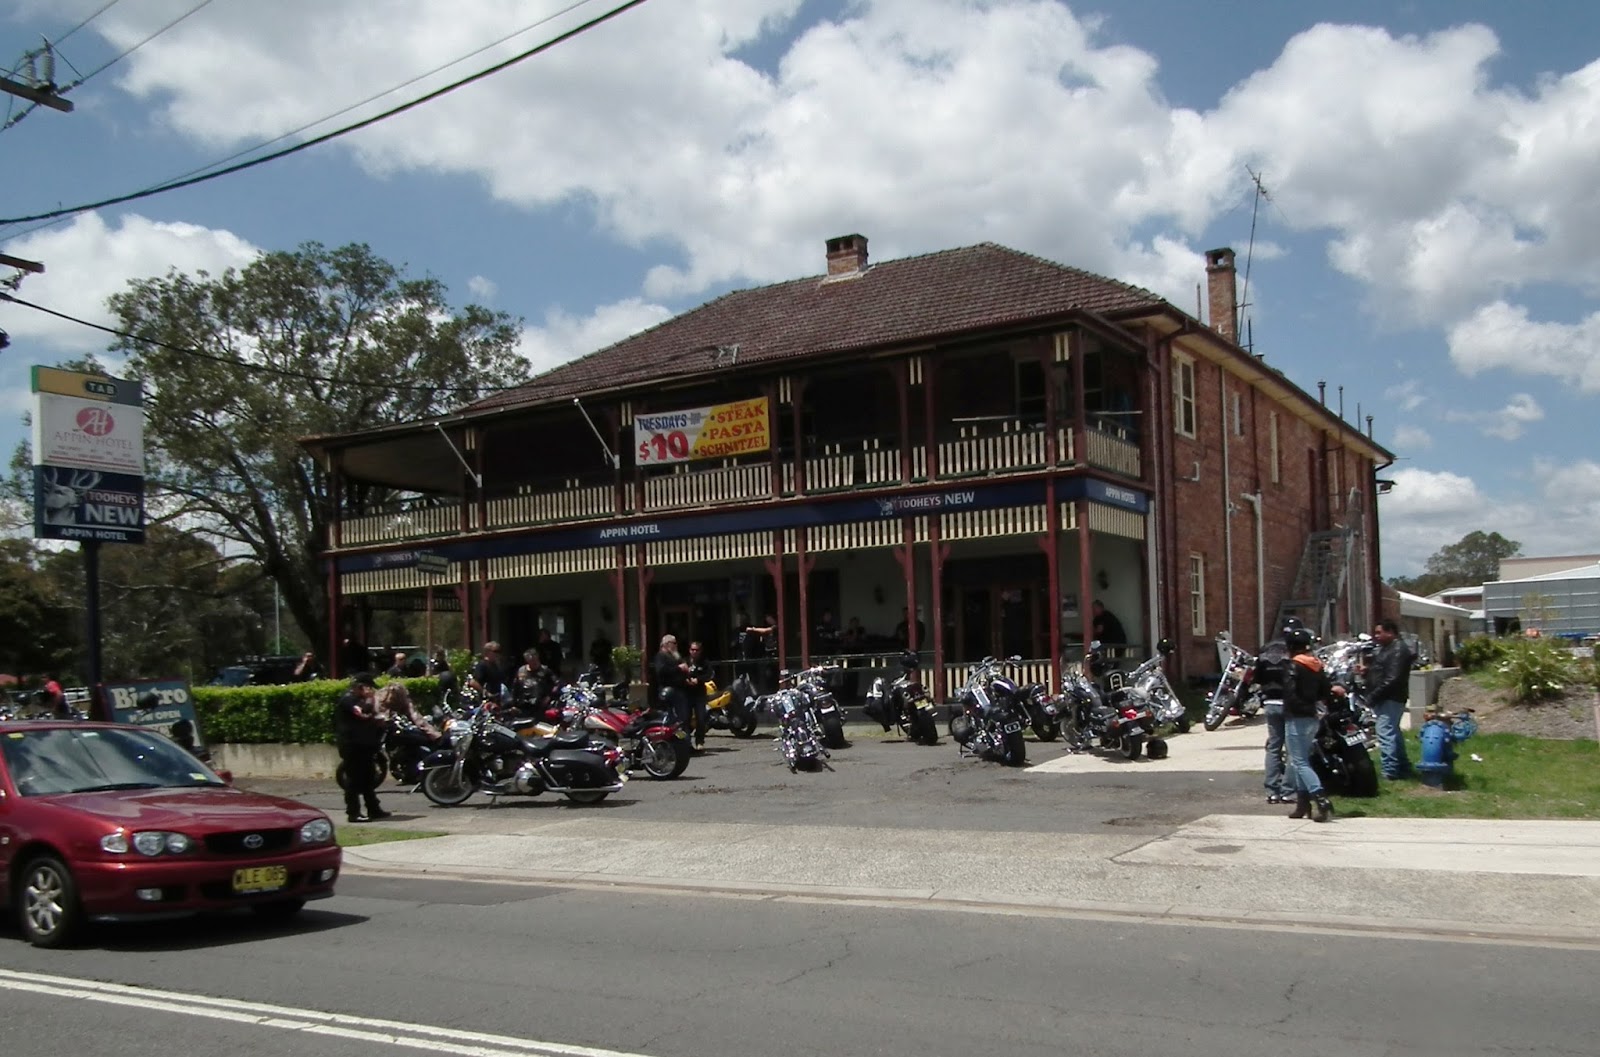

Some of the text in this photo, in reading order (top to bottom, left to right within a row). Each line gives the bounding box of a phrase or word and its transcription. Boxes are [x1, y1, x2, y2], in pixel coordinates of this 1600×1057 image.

[89, 382, 115, 394] TAB
[637, 413, 687, 431] TUESDAYS
[717, 403, 765, 424] STEAK
[709, 421, 765, 440] PASTA
[54, 431, 91, 445] APPIN
[96, 436, 134, 450] HOTEL
[639, 431, 689, 460] $10
[701, 435, 767, 457] SCHNITZEL
[90, 491, 138, 505] TOOHEYS
[944, 491, 975, 505] NEW
[84, 503, 140, 526] NEW
[60, 528, 128, 541] APPIN HOTEL
[600, 524, 660, 539] APPIN HOTEL
